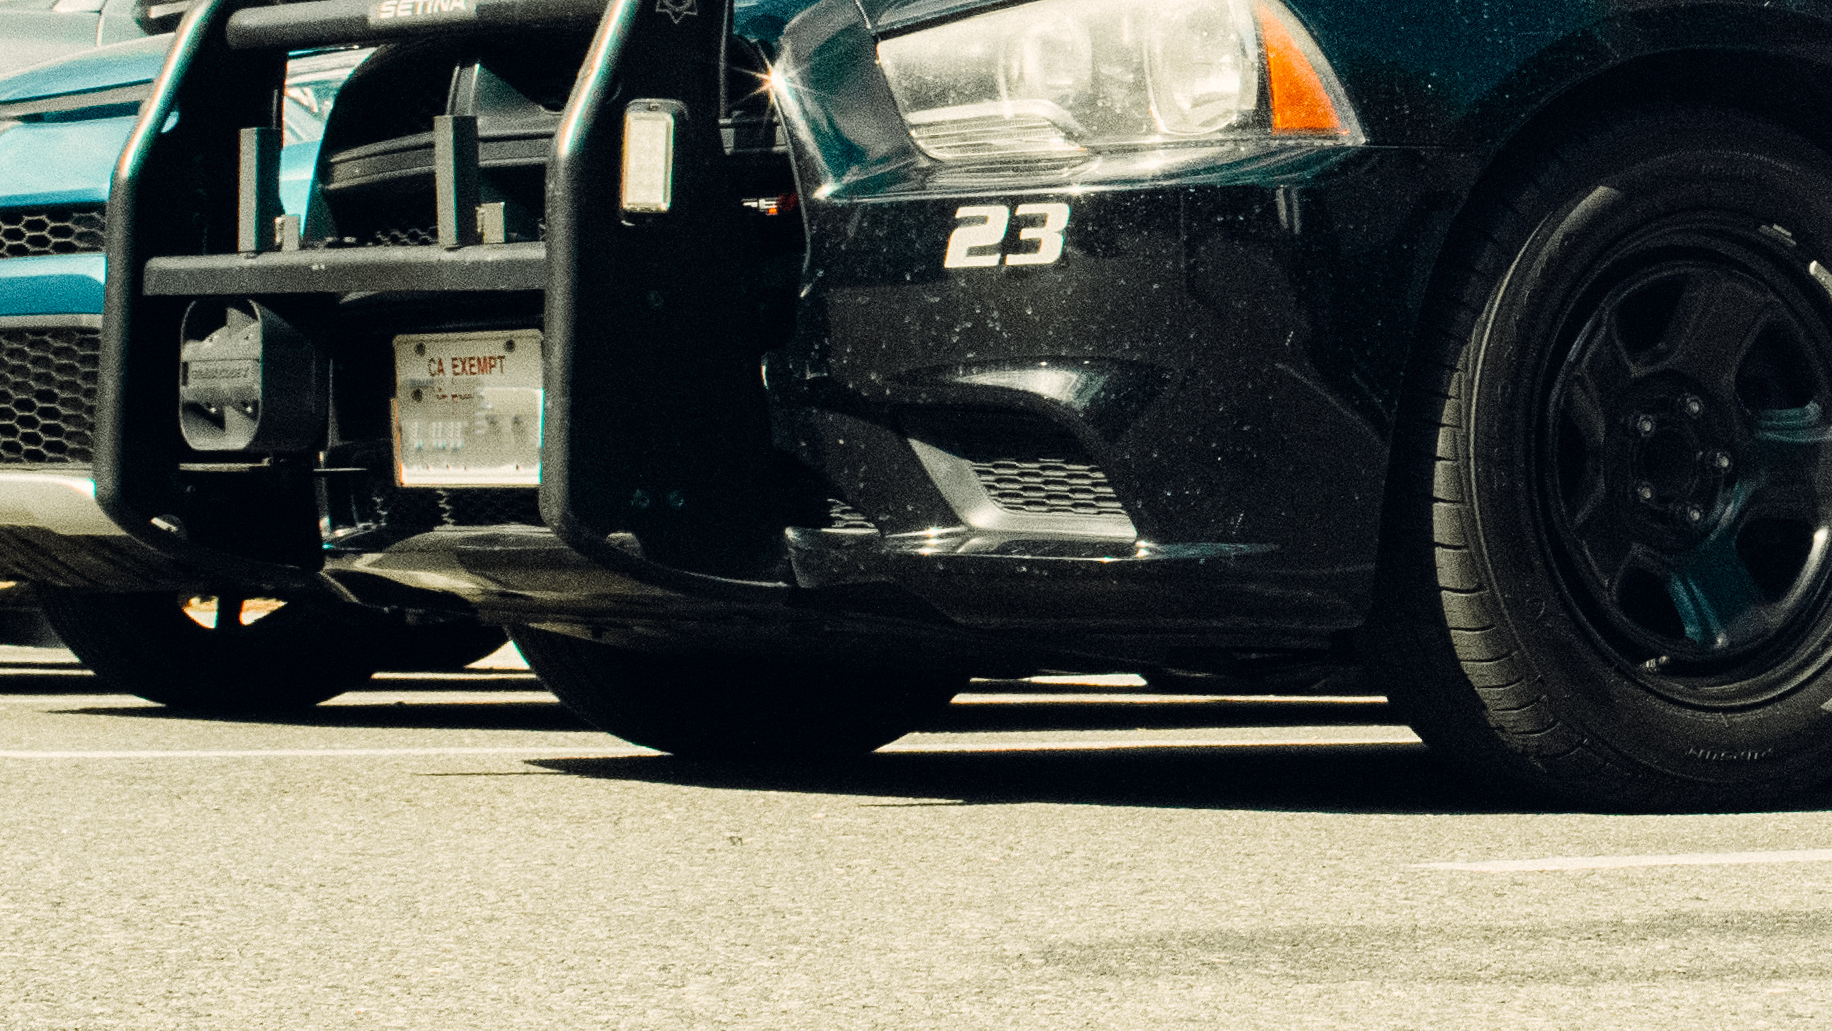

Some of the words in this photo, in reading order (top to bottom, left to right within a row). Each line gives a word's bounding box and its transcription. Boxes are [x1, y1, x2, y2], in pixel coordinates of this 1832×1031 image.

[944, 202, 1070, 268] 23
[427, 357, 445, 377] CA
[451, 355, 505, 377] EXEMPT
